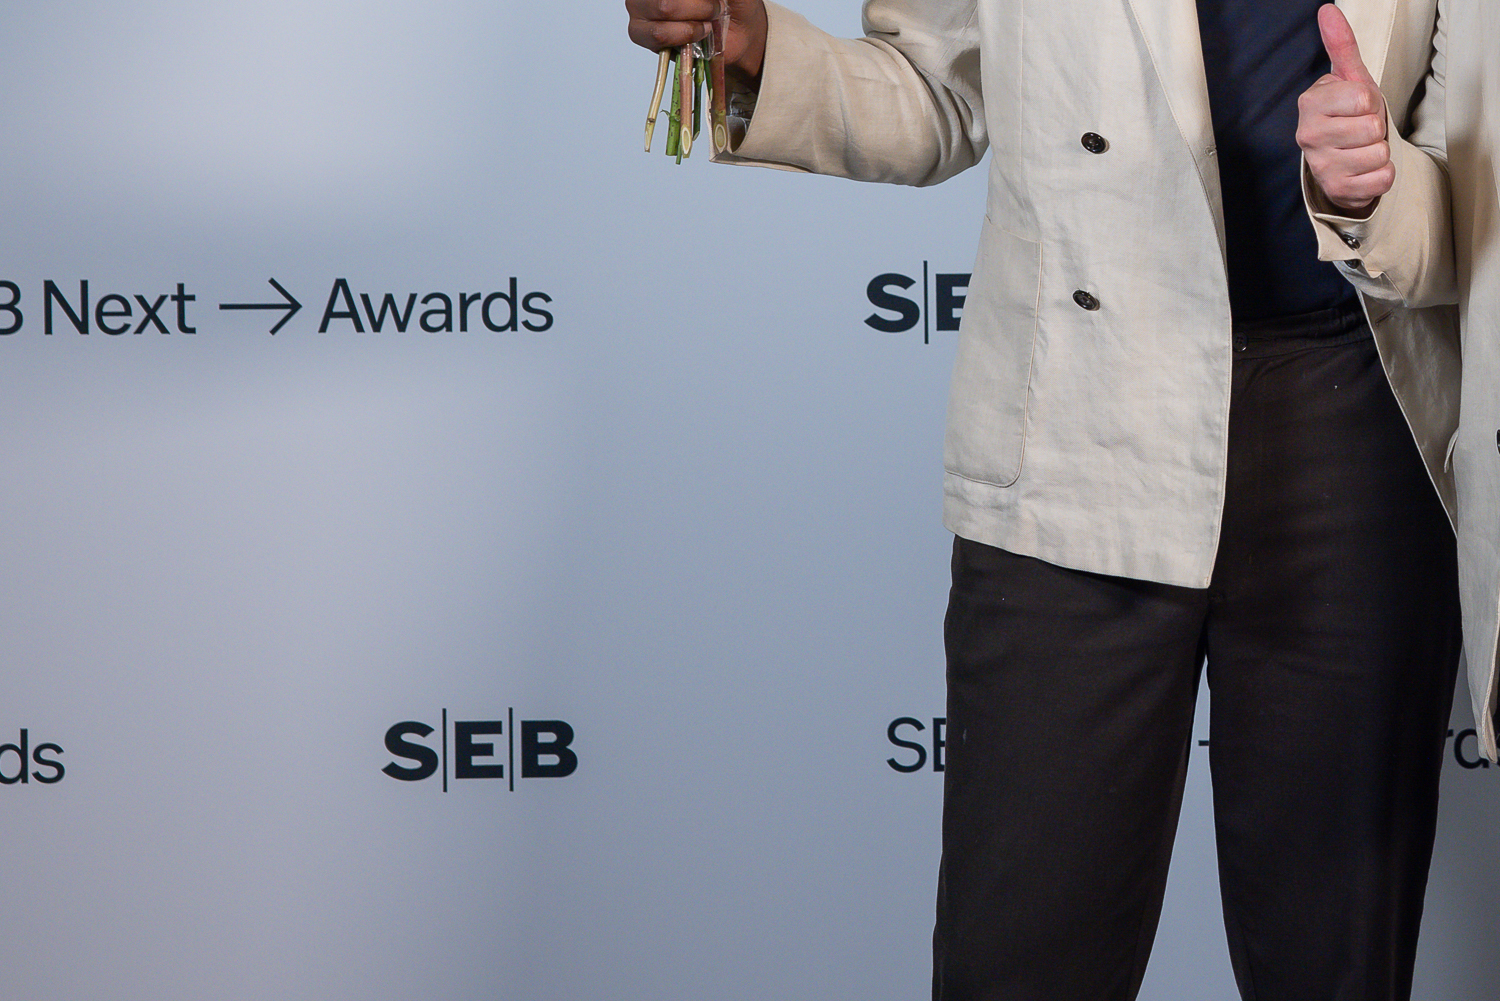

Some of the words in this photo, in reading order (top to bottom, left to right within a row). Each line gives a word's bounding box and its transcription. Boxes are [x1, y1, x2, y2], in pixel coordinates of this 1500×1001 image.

[44, 280, 196, 335] Next
[318, 277, 553, 333] Awards
[864, 272, 971, 333] SE
